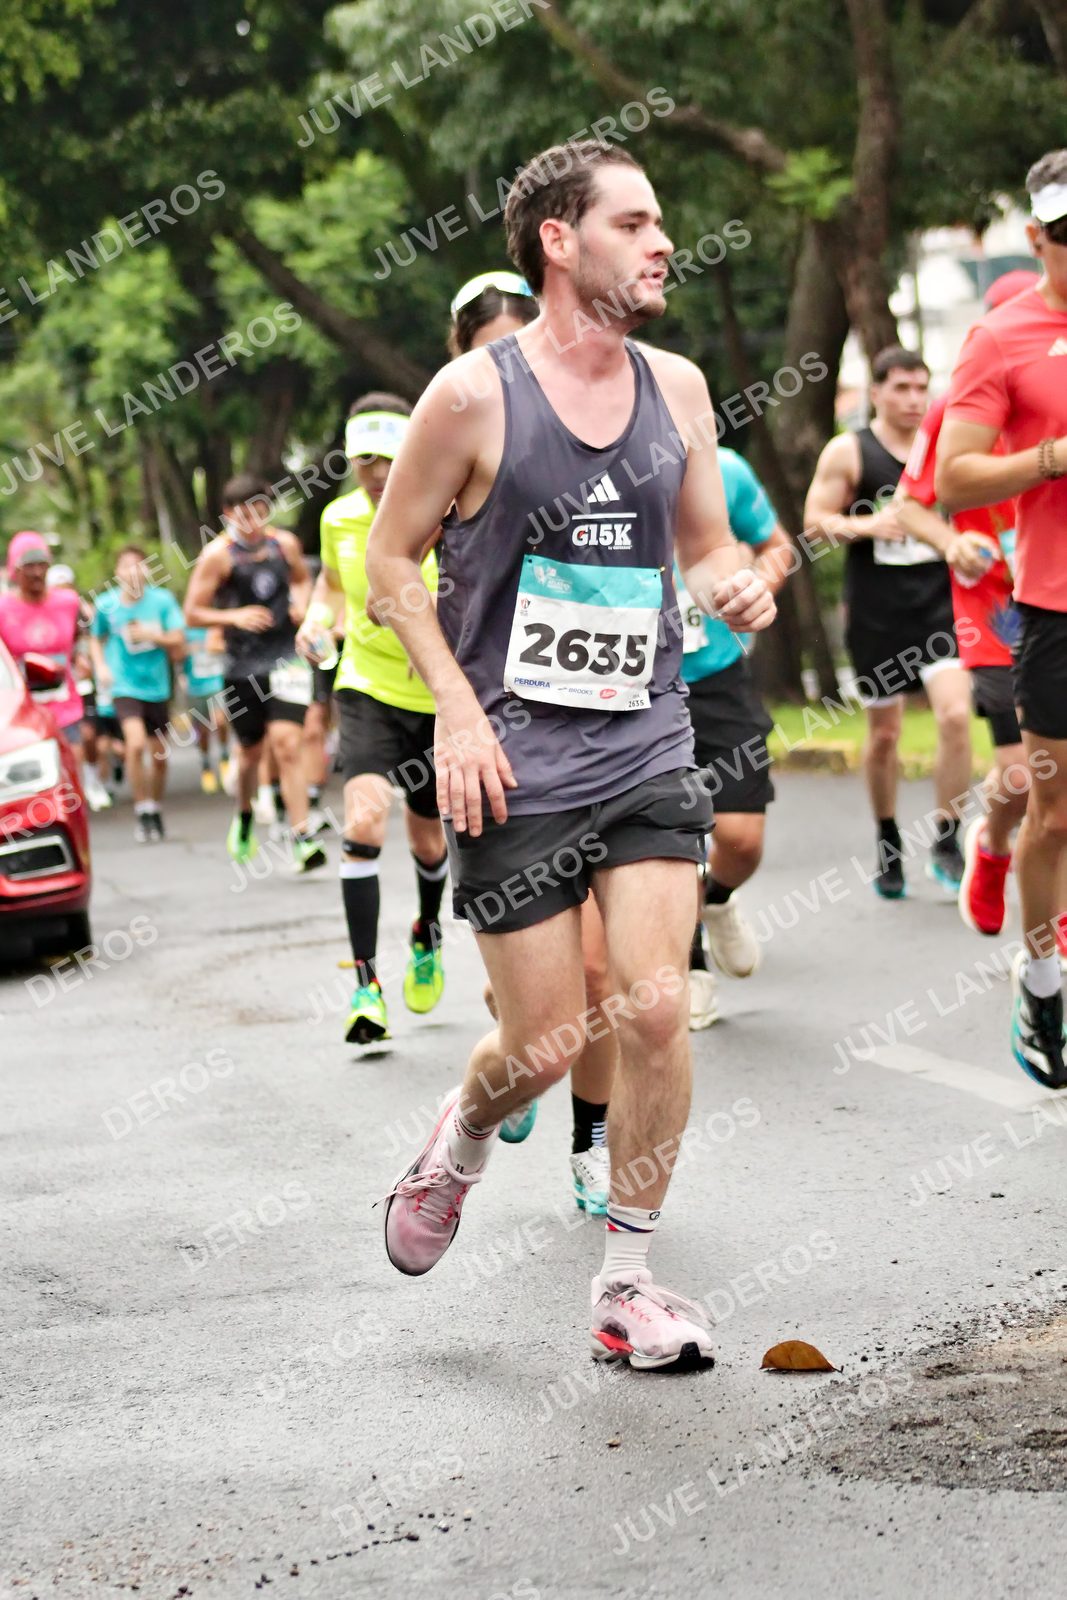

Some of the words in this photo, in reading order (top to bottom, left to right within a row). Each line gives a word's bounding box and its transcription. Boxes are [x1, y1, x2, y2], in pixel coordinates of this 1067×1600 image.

[572, 523, 632, 546] G15K
[519, 622, 648, 677] 2635
[514, 677, 551, 688] PERDURA
[568, 687, 593, 695] BROOKS
